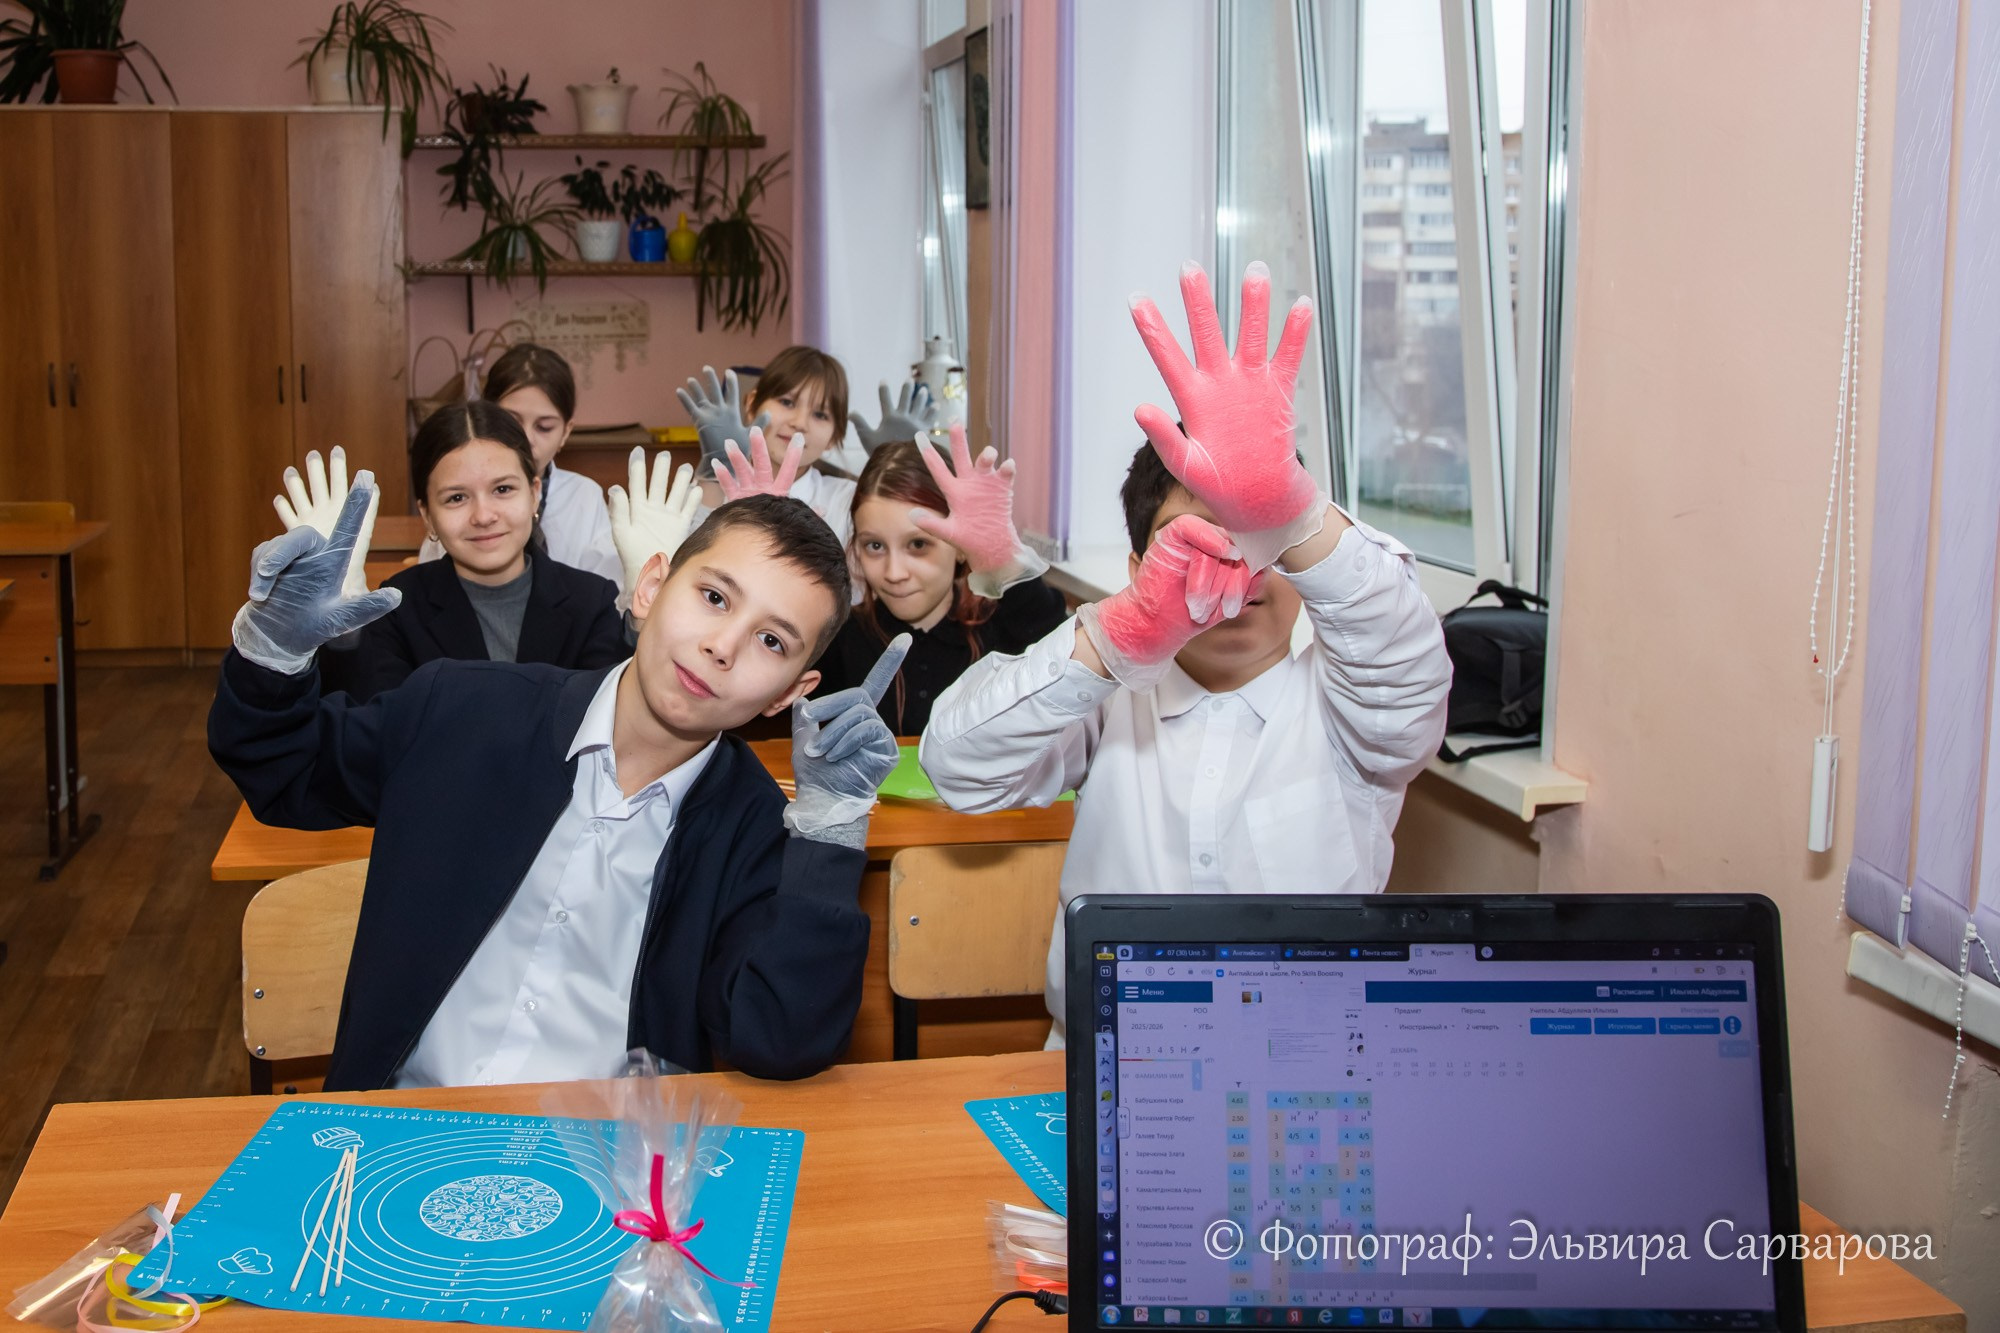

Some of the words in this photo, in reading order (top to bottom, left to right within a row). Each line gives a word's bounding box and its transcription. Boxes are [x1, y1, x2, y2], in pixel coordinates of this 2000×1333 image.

[1317, 970, 1344, 978] Boosting
[1408, 968, 1437, 976] Журнал
[1612, 988, 1655, 996] Расписание
[1126, 1008, 1137, 1016] Год
[1461, 1008, 1486, 1016] Период
[1131, 1023, 1164, 1031] 2025/2026
[1546, 1023, 1575, 1031] Журнал
